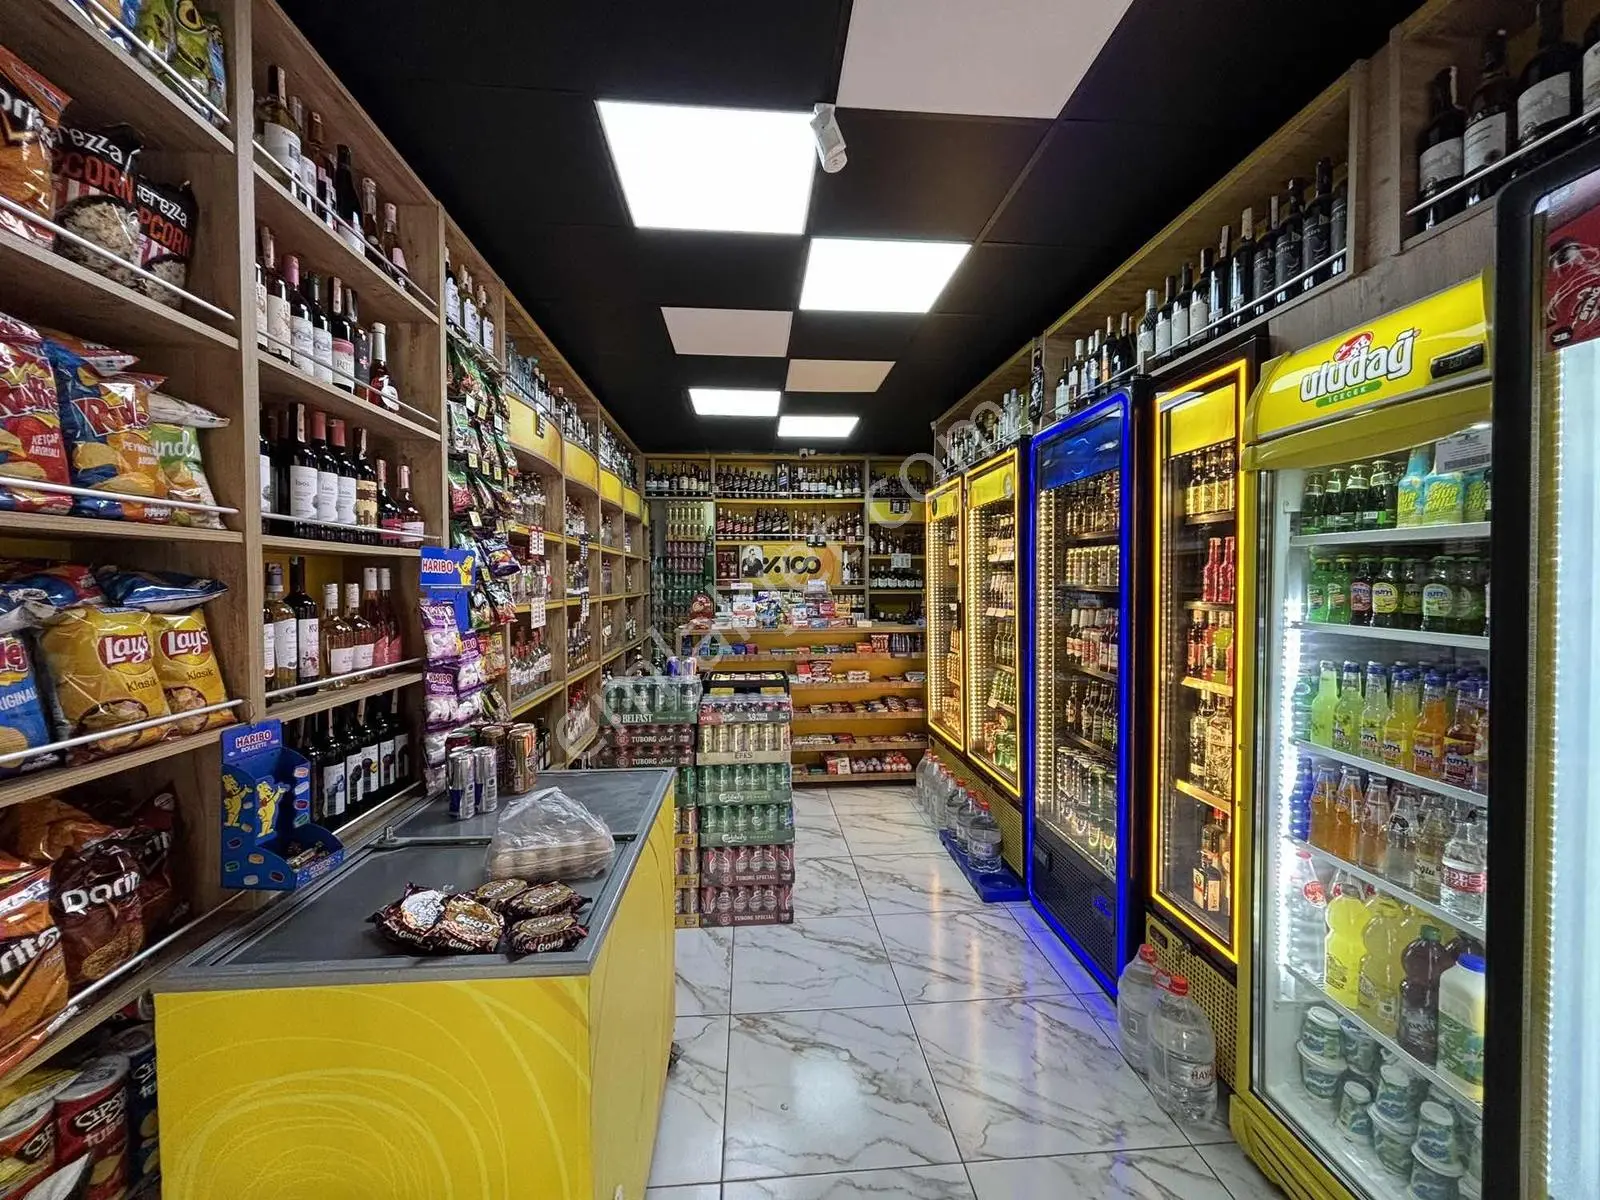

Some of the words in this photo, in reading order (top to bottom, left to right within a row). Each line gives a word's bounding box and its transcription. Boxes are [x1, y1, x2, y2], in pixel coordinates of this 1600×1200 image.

[422, 558, 453, 573] HARIBO
[187, 668, 214, 681] Klasik
[622, 713, 653, 724] BELFAST
[235, 730, 272, 748] HARIBO
[484, 878, 515, 897] Gong
[399, 930, 424, 944] Gong
[449, 939, 475, 952] Gong
[537, 937, 565, 952] Gong
